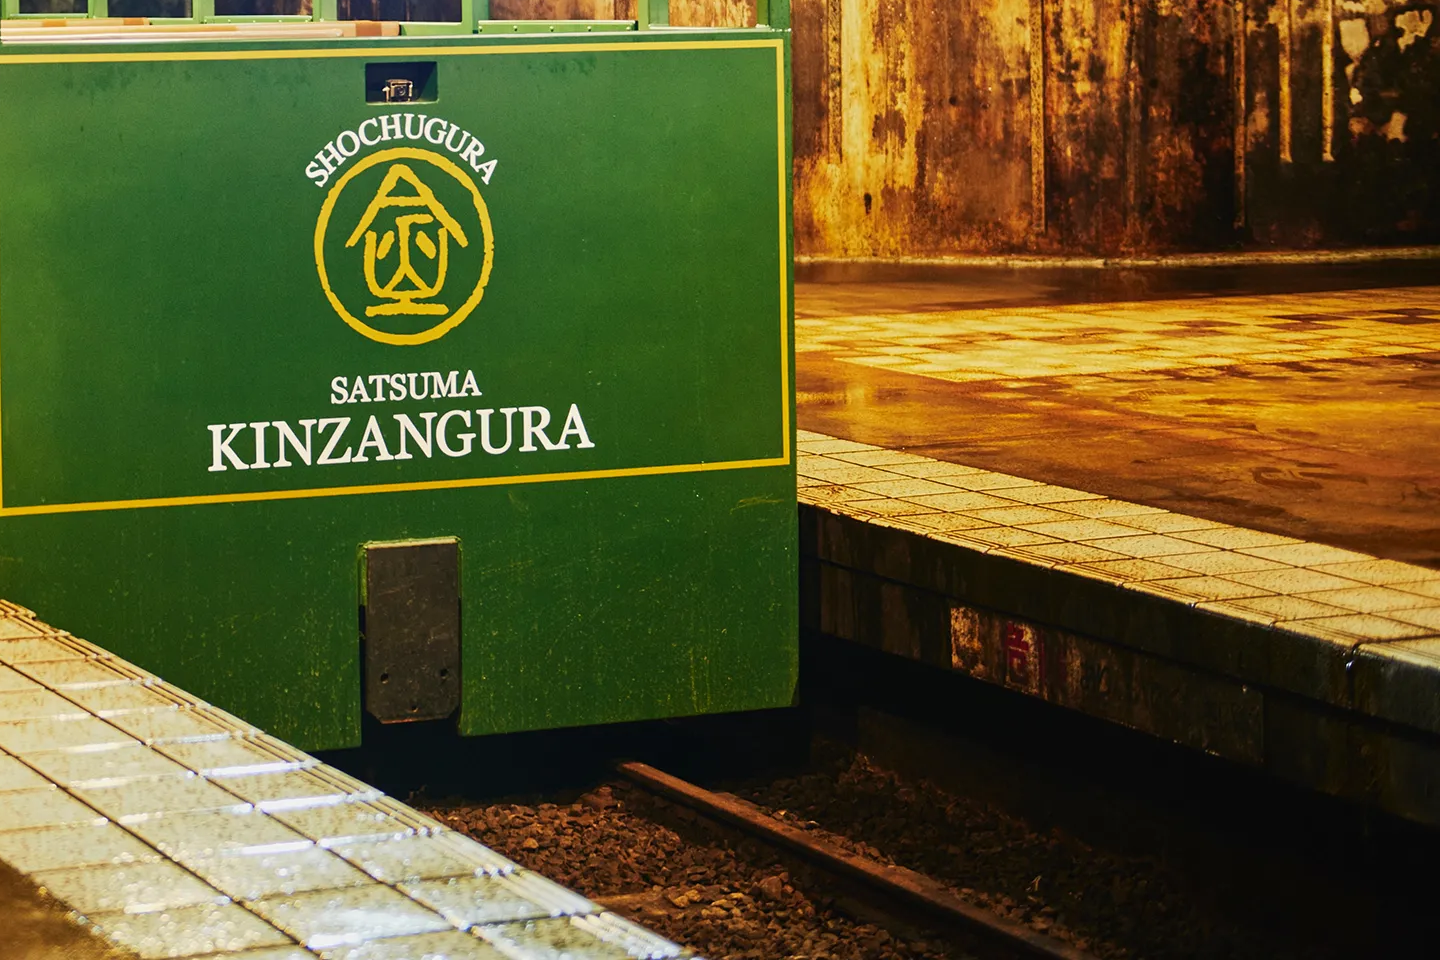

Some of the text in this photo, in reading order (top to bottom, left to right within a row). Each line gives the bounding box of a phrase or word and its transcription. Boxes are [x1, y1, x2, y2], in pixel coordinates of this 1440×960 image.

[304, 113, 498, 187] SHOCHUGURA
[330, 369, 482, 404] SATSUMA
[207, 403, 596, 472] KINZANGURA
